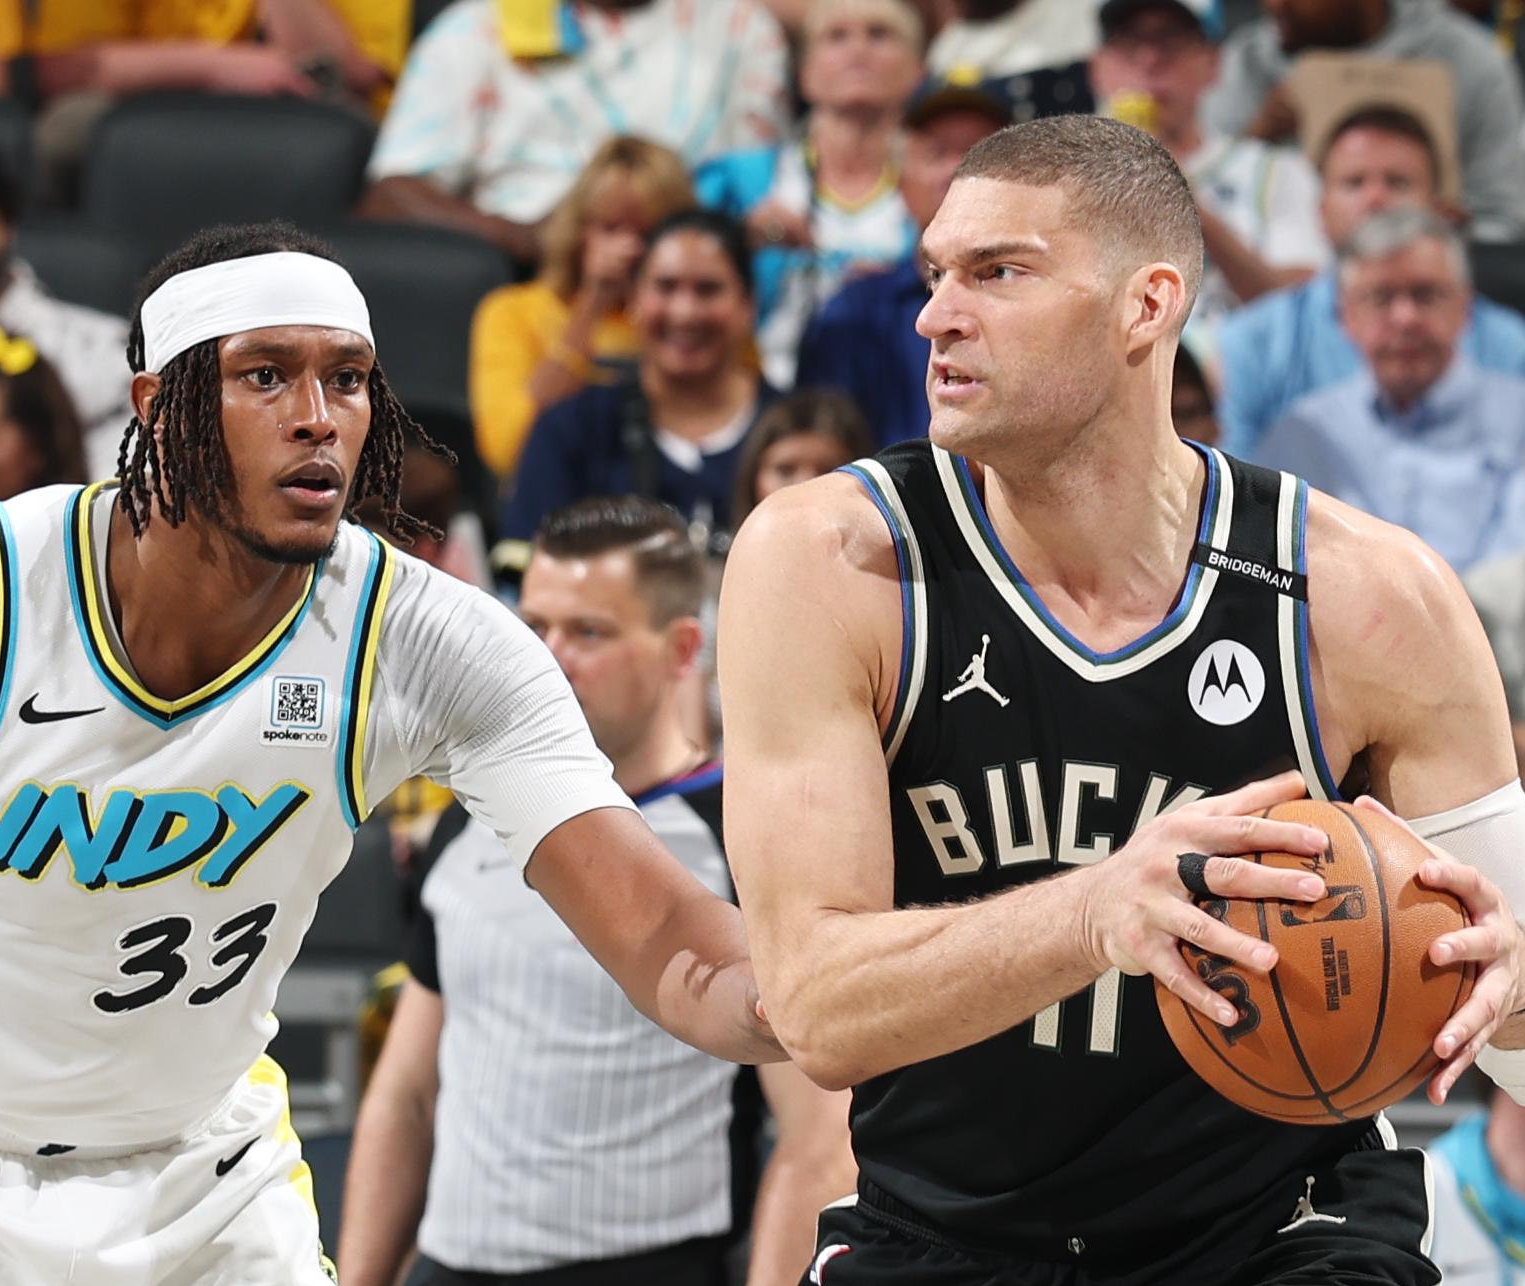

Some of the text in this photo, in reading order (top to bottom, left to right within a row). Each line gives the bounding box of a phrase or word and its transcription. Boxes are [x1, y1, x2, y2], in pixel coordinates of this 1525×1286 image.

[1208, 551, 1293, 591] BRIDGEMAN
[263, 729, 328, 742] spokenote
[906, 757, 1213, 877] BUCK
[91, 900, 279, 1013] 33
[1320, 936, 1335, 955] BALL
[1322, 955, 1337, 977] GAME
